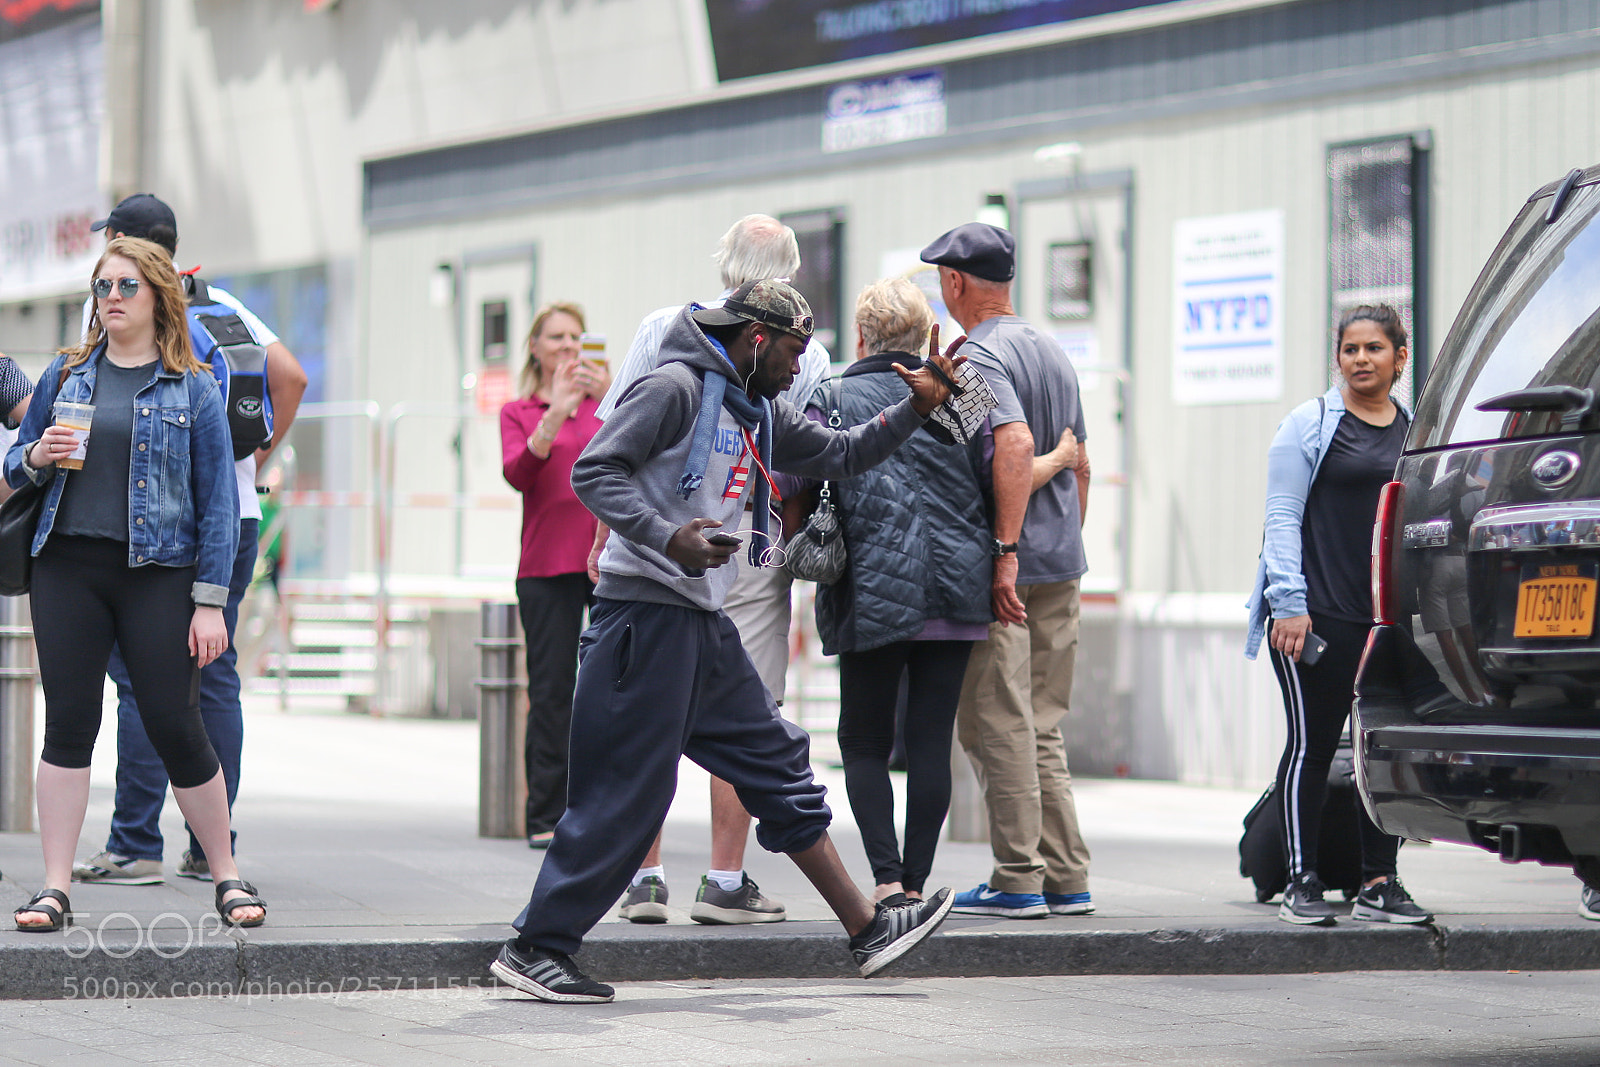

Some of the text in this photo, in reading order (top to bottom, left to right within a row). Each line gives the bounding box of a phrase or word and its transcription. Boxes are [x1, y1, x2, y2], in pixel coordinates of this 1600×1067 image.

[1184, 293, 1272, 333] NYPD
[1535, 457, 1564, 478] Ford
[1523, 582, 1588, 623] T735818C
